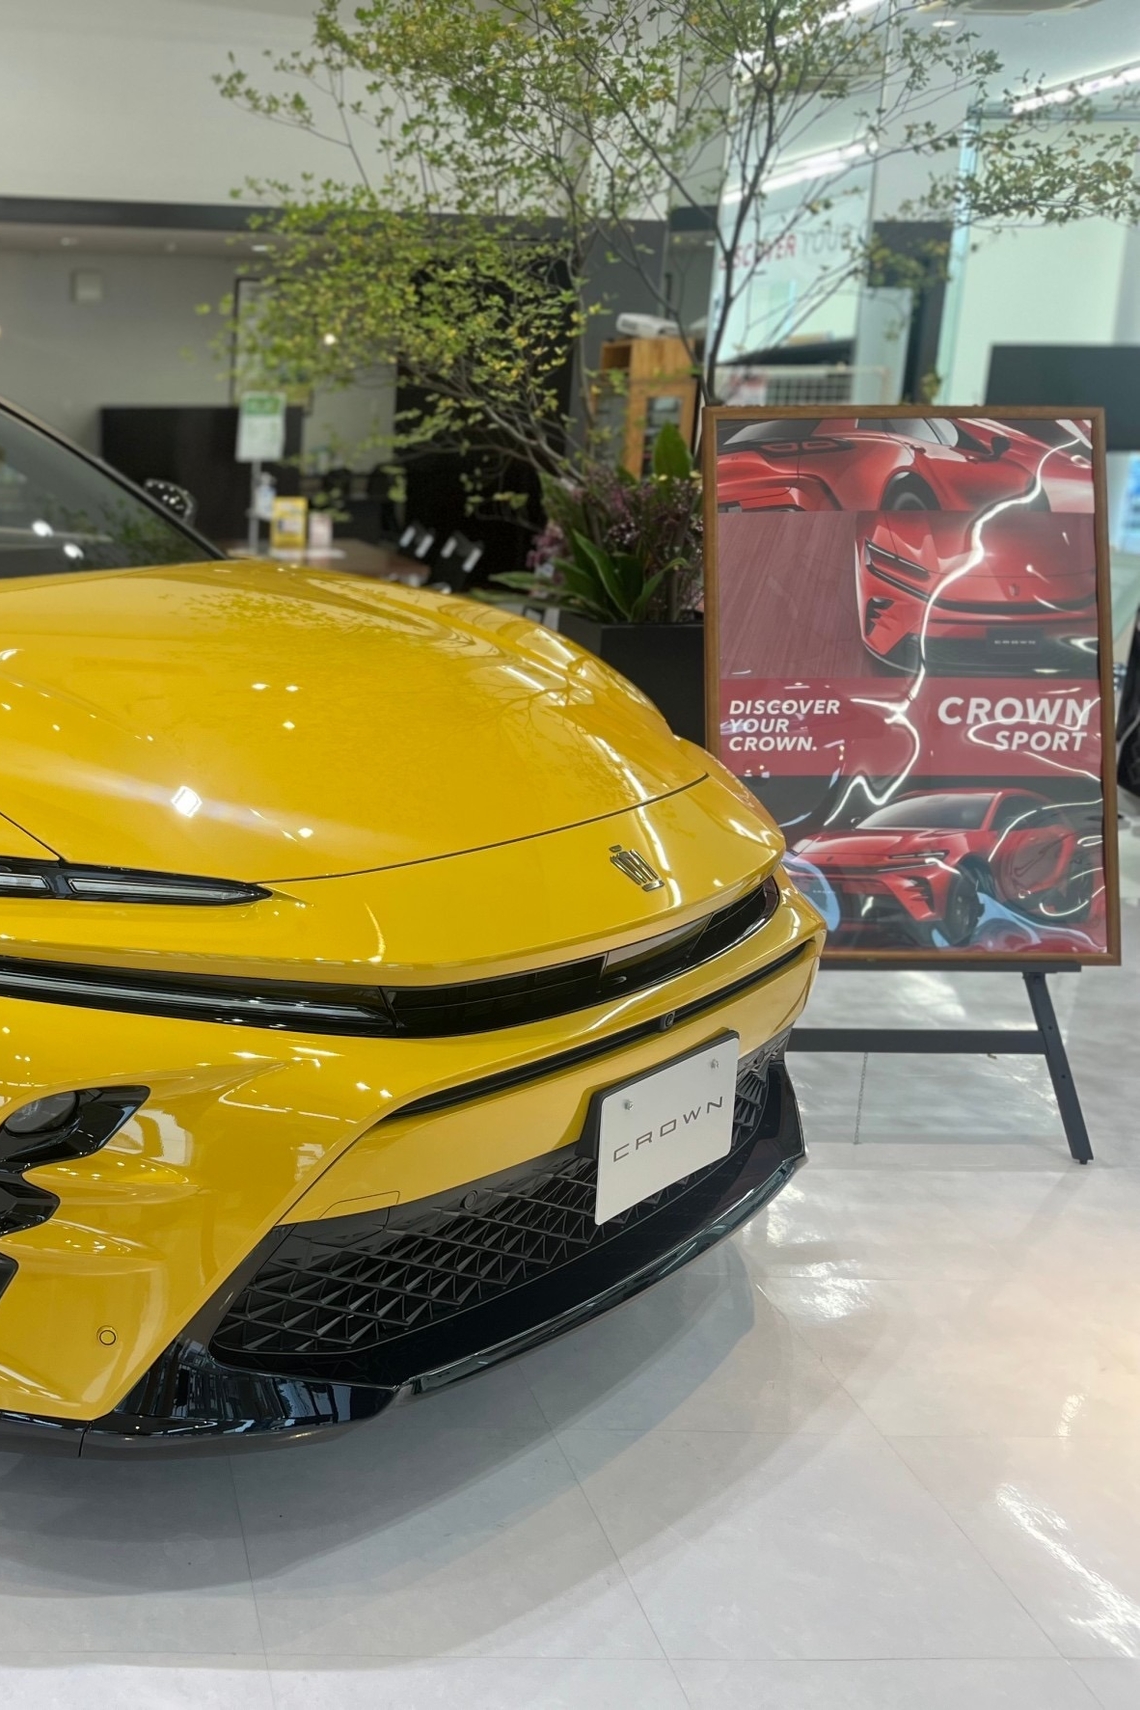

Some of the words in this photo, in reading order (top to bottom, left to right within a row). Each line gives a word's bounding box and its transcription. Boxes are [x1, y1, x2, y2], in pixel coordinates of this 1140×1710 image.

[718, 234, 796, 269] SCVER
[801, 229, 853, 255] YOU
[729, 700, 840, 715] DISCOVER
[938, 697, 1091, 726] CROWN
[730, 718, 789, 733] YOUR
[729, 737, 817, 751] CROWN.
[994, 731, 1088, 752] SPORT
[613, 1096, 723, 1163] CROWN
